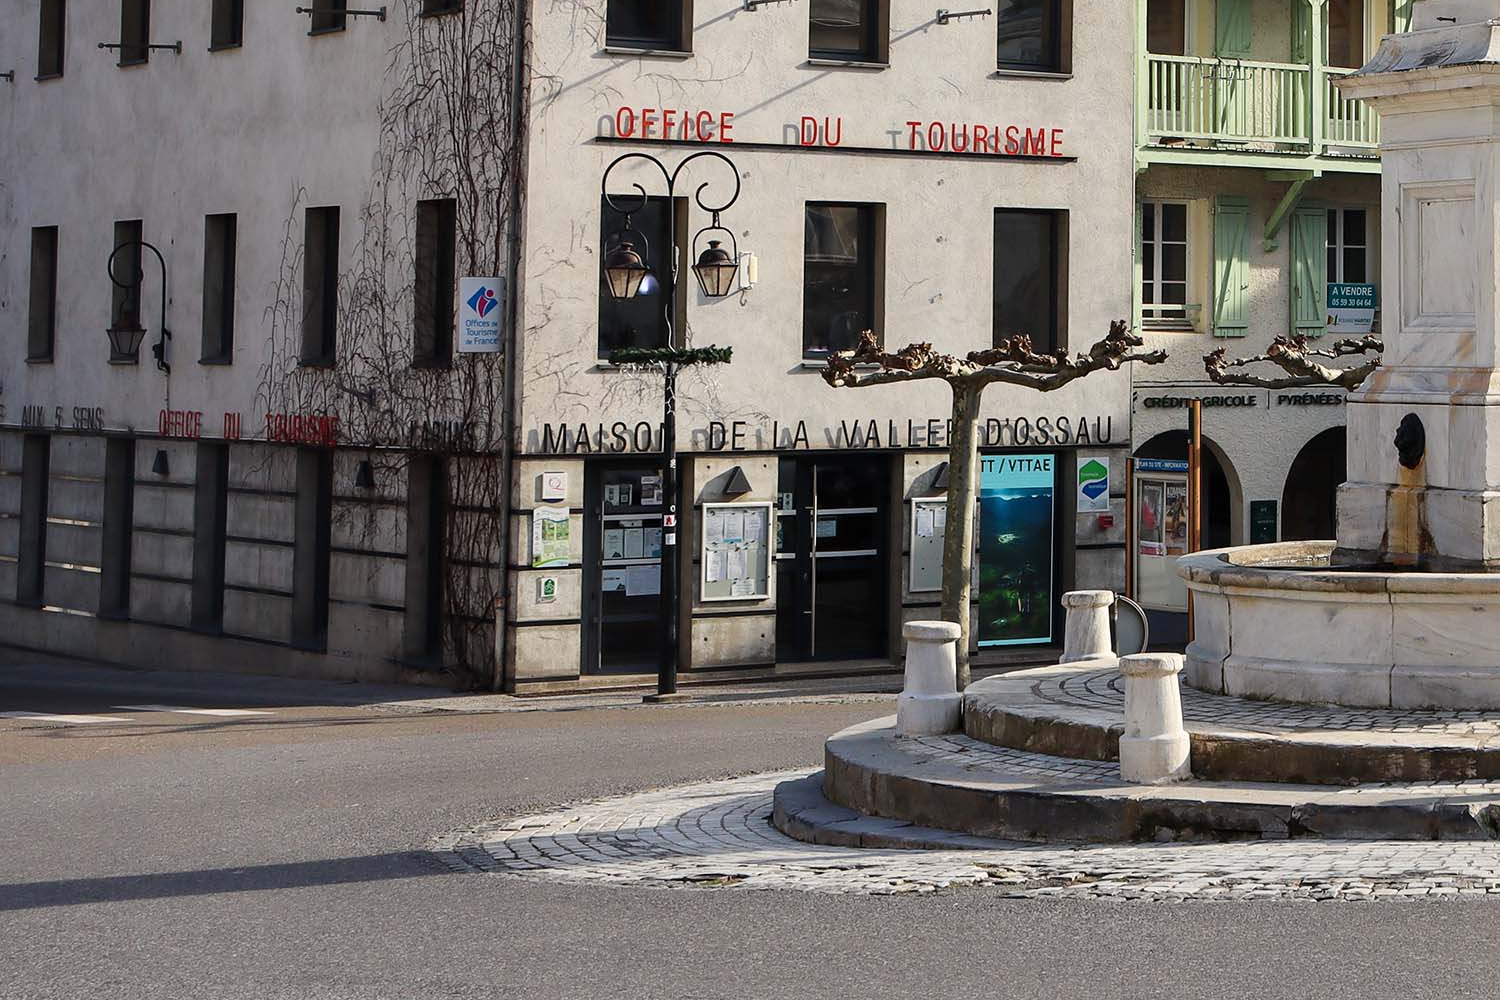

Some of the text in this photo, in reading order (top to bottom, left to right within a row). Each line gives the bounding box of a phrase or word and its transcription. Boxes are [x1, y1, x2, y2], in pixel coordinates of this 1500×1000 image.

[616, 107, 1064, 156] OFFICE DU TOURISME
[1332, 286, 1373, 297] A VENDRE
[465, 320, 490, 328] Offices
[474, 337, 498, 345] France
[1143, 393, 1257, 409] CRÉDIT GRICOLE
[1277, 392, 1343, 406] PYRÉNÉES
[22, 405, 44, 428] AUX
[72, 406, 105, 431] SENS
[159, 409, 338, 447] OFFICE DU TOURISME
[708, 420, 747, 451] DE
[772, 419, 811, 450] LA
[986, 415, 1112, 447] D'OSSAU
[980, 460, 995, 473] TT
[1008, 459, 1051, 472] VTTAE
